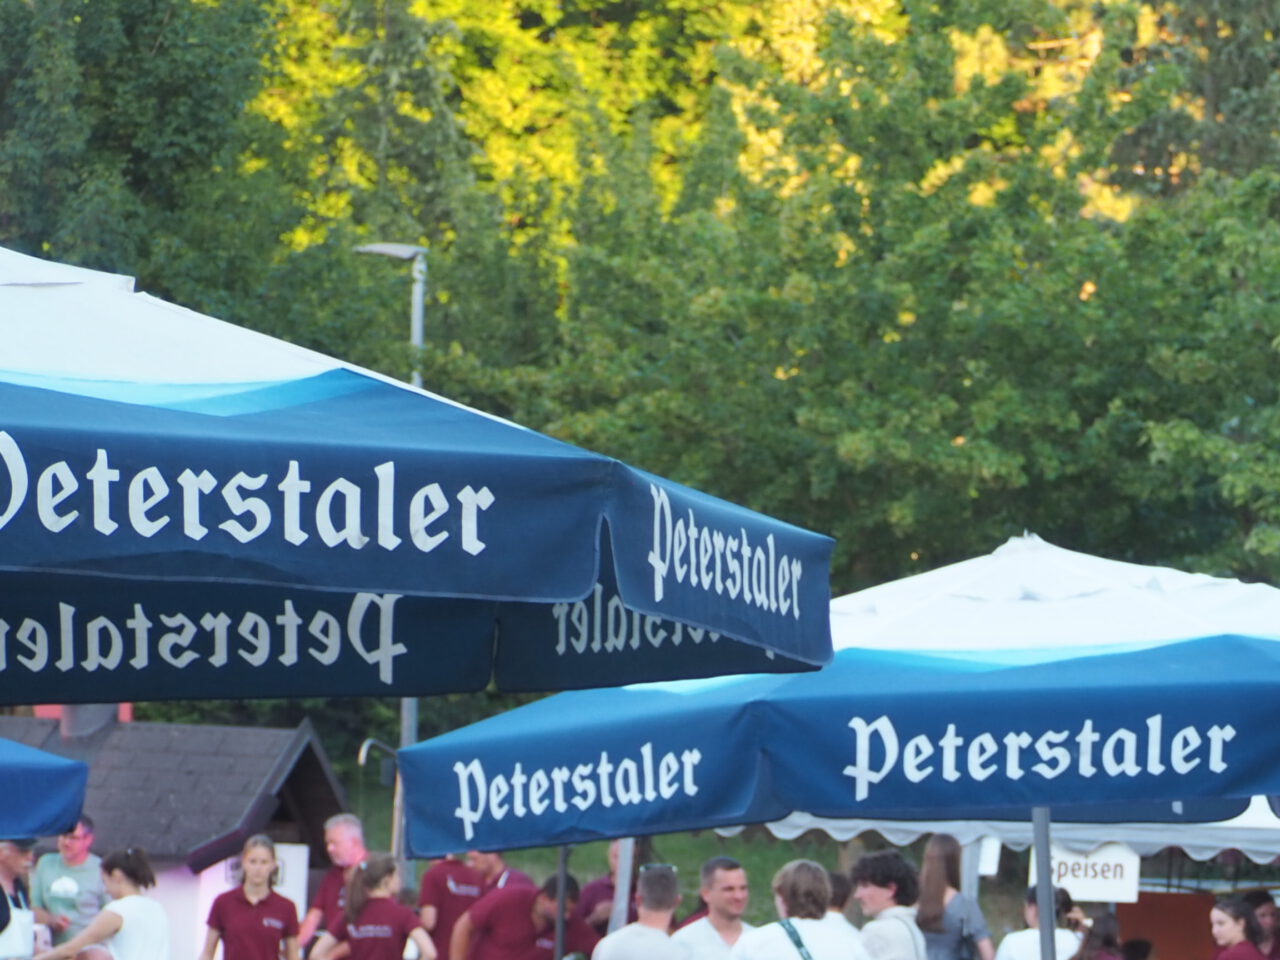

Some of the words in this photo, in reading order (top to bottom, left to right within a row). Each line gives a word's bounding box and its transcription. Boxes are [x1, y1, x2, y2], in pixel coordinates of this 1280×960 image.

[648, 483, 802, 620] Peterstaler
[453, 742, 703, 841] Peterstaler
[844, 714, 1237, 803] Peterstaler
[1051, 861, 1124, 883] peisen
